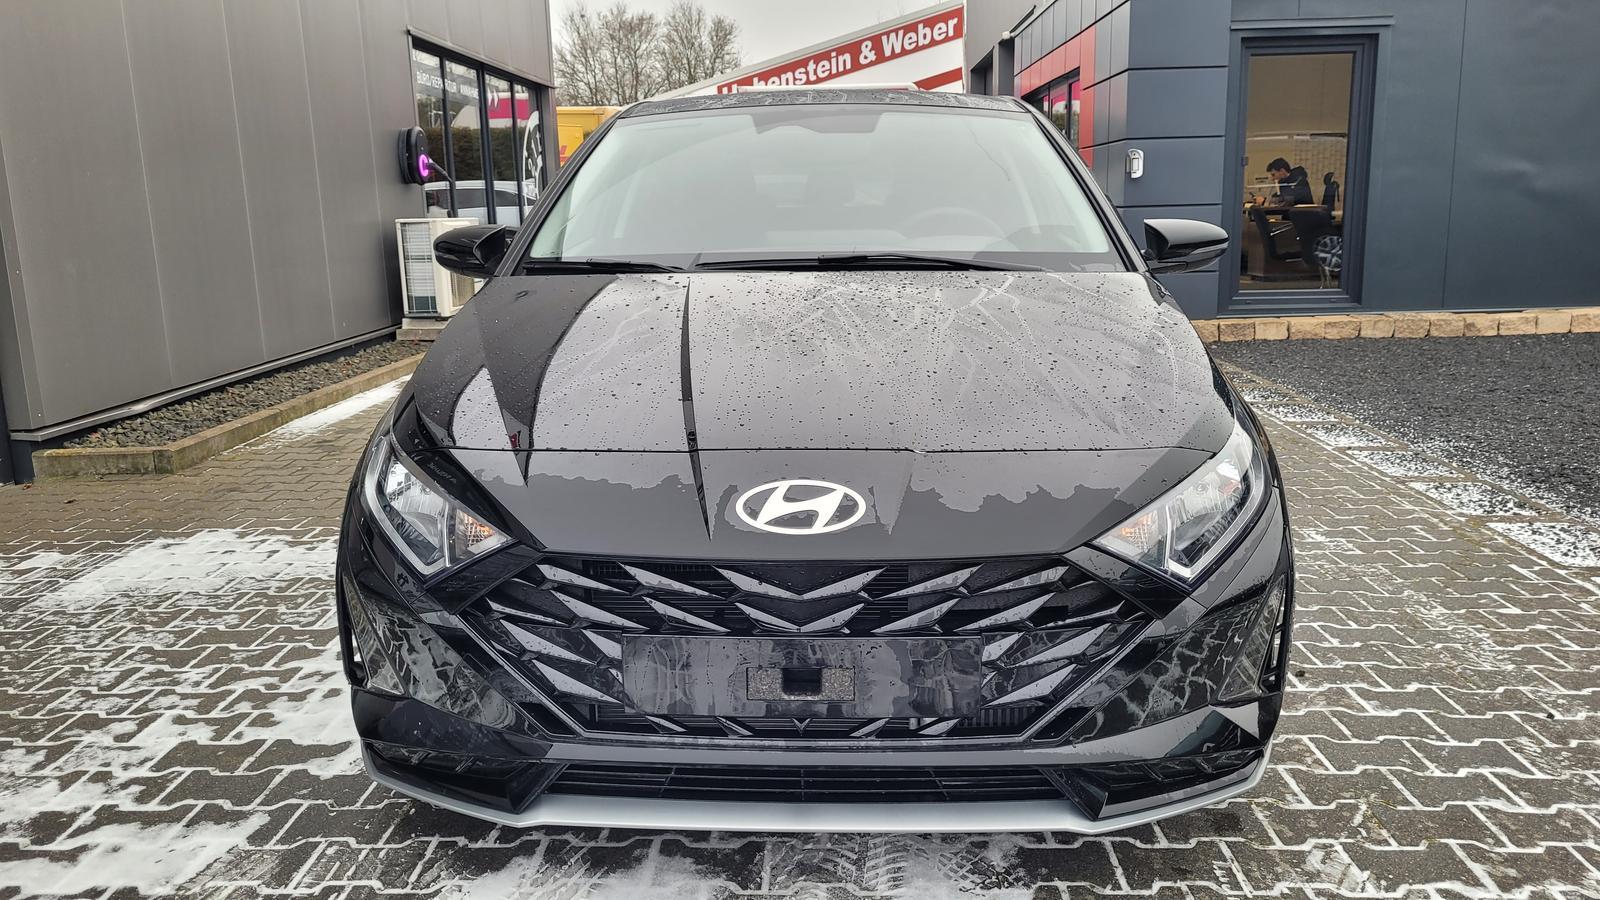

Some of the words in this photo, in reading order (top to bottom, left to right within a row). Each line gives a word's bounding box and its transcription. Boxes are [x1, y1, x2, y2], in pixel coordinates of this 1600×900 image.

[722, 52, 852, 94] enstein
[859, 40, 876, 65] &
[881, 15, 959, 57] Weber
